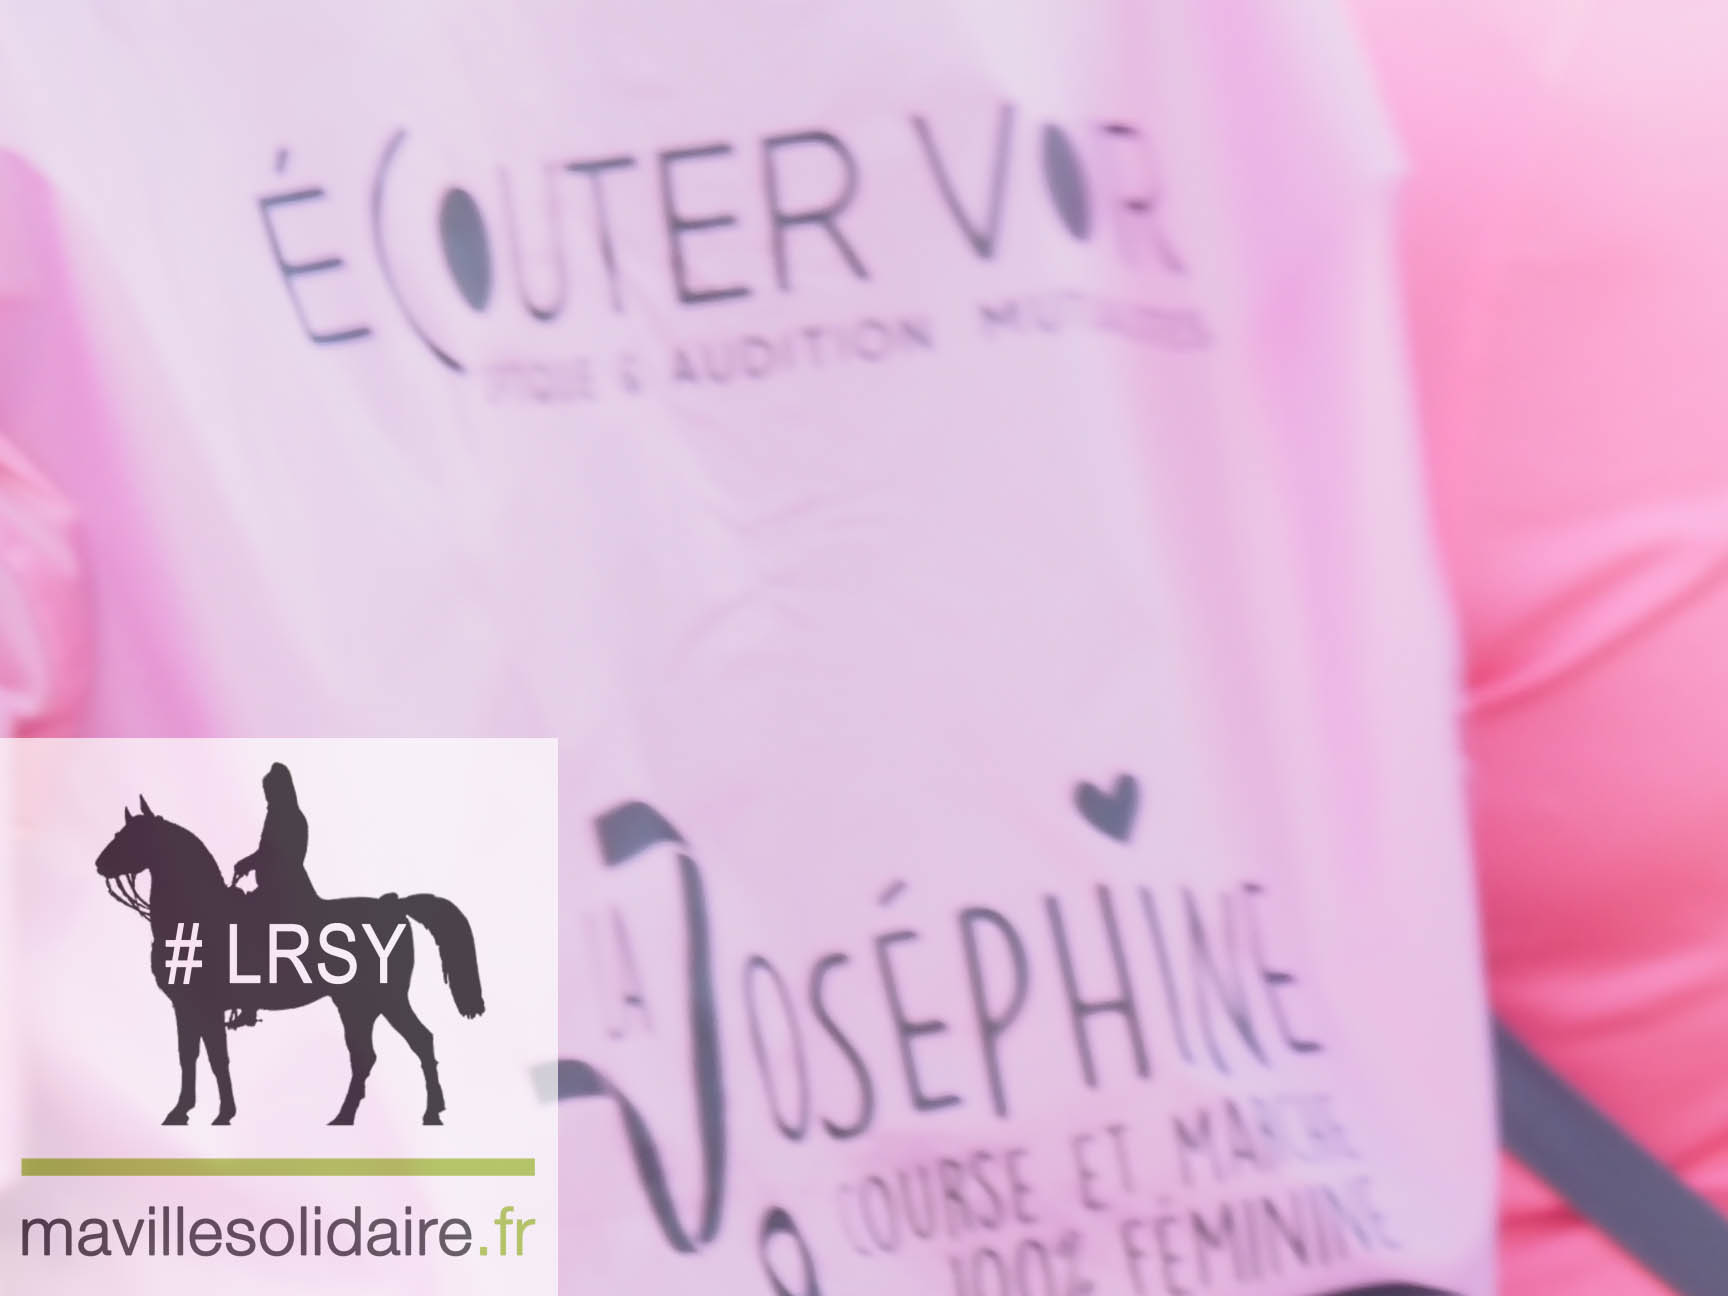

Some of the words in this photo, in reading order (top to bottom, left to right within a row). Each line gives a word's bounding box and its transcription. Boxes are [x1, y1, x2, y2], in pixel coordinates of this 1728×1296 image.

[256, 126, 872, 374] ÉCOUTER
[670, 317, 932, 385] AUDITION
[556, 801, 1323, 1253] JOSÉPHINE
[839, 1148, 1037, 1256] COURSE
[1072, 1122, 1133, 1212] ET
